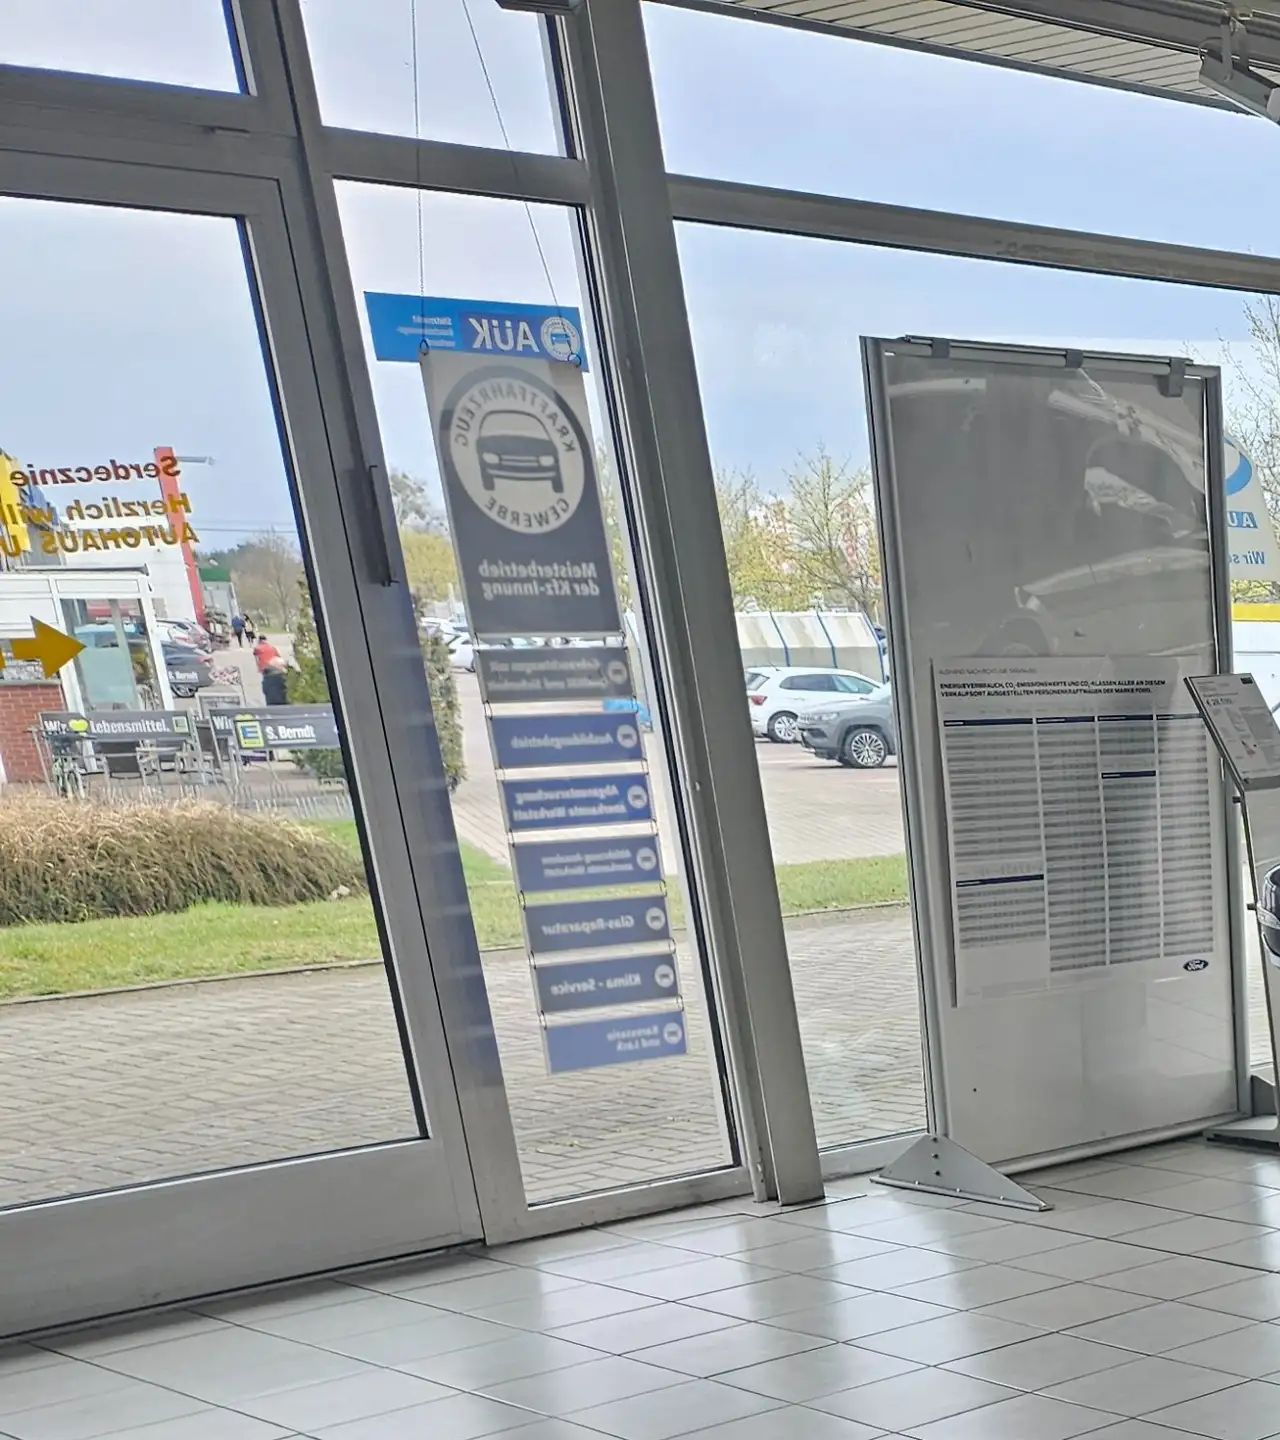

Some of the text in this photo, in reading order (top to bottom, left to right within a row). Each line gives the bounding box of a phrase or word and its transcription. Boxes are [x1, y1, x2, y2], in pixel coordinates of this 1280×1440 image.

[44, 719, 67, 735] Wir
[90, 717, 170, 734] Lebensmittel.
[278, 724, 315, 739] Berndt
